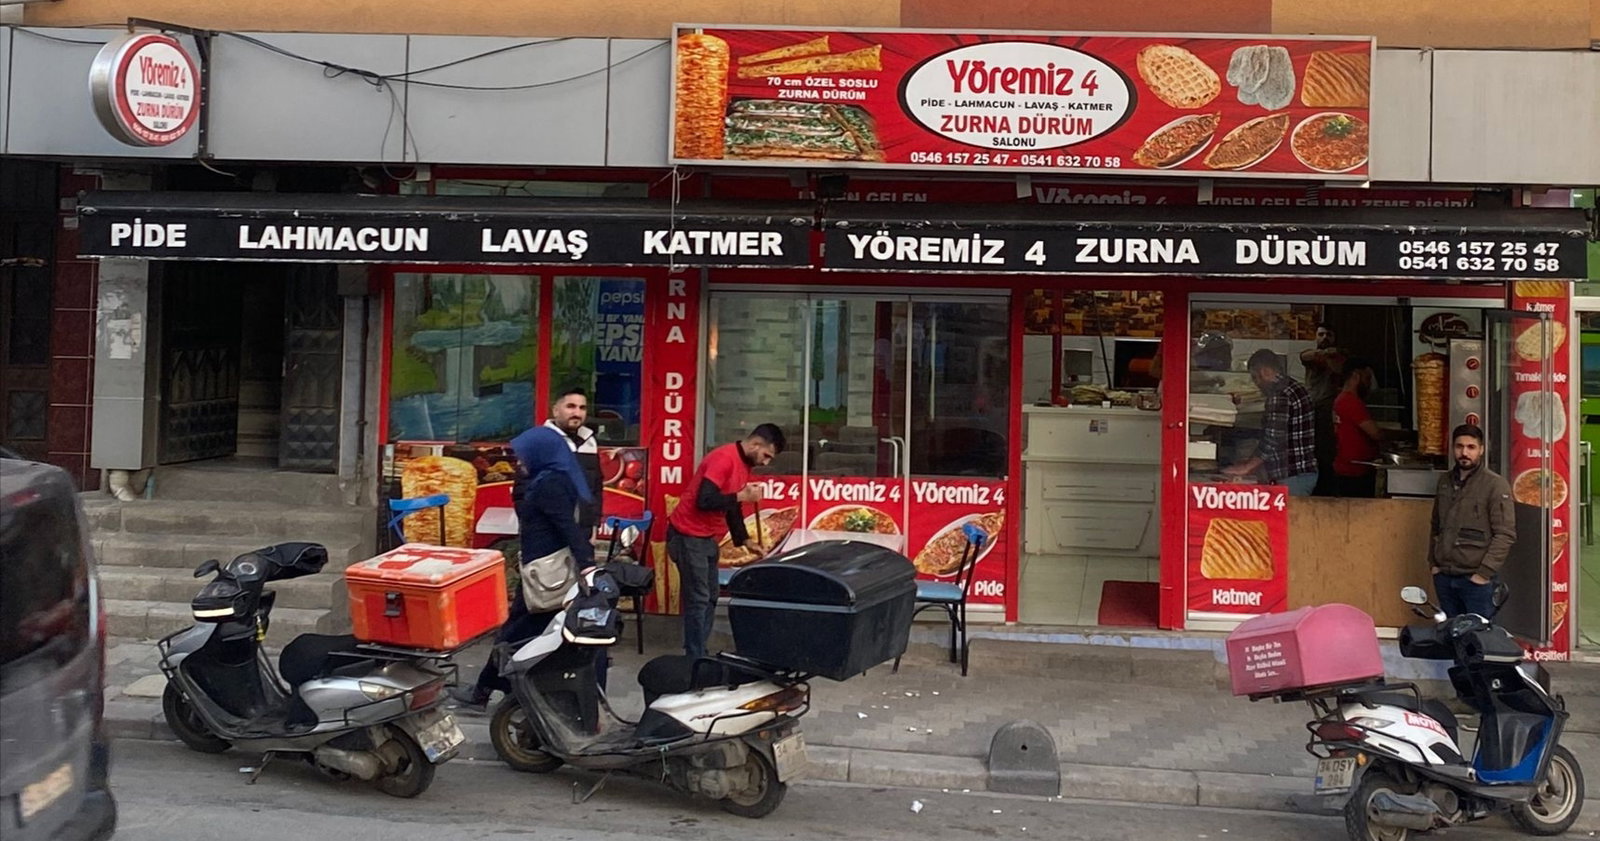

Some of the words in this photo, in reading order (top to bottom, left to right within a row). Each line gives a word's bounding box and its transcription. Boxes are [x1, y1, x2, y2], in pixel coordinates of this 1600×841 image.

[139, 55, 179, 88] Yöremiz
[181, 67, 186, 89] 4
[946, 59, 1075, 96] Yöremiz
[1080, 70, 1099, 97] 4
[767, 76, 782, 86] 70
[784, 78, 802, 87] cm
[804, 75, 836, 88] ÖZEL
[839, 78, 878, 88] SOSLU
[778, 89, 820, 100] ZURNA
[822, 88, 866, 101] DÜRÜM
[920, 98, 946, 108] PİDE
[954, 99, 1015, 110] LAHMACUN
[1024, 101, 1059, 112] LAVAŞ
[1068, 102, 1113, 112] KATMER
[940, 115, 1012, 134] ZURNA
[1018, 114, 1093, 136] DÜRÜM
[992, 136, 1036, 147] SALONU
[910, 152, 942, 164] 0546
[946, 152, 970, 164] 157
[973, 152, 990, 164] 25
[992, 153, 1009, 165] 47
[1020, 154, 1052, 166] 0541
[1056, 154, 1081, 166] 632
[1084, 155, 1100, 167] 70
[1104, 156, 1121, 168] 58
[110, 218, 187, 247] PİDE
[239, 225, 429, 252] LAHMACUN
[481, 228, 588, 260] LAVAŞ
[643, 230, 783, 256] KATMER
[847, 230, 1006, 265] YÖREMİZ
[1025, 240, 1046, 266] 4
[1075, 238, 1200, 264] ZURNA
[1236, 234, 1366, 266] DÜRÜM
[1399, 241, 1450, 256] 0546
[1456, 242, 1495, 256] 157
[1501, 242, 1527, 256] 25
[1533, 242, 1560, 257] 47
[1399, 256, 1449, 270] 0541
[1456, 257, 1496, 271] 632
[1502, 258, 1528, 272] 70
[1533, 258, 1560, 272] 58
[600, 290, 645, 306] pepsi
[593, 324, 645, 347] EPSI
[660, 372, 684, 484] DÜRÜM
[788, 482, 800, 500] 4
[809, 478, 886, 502] Yöremiz
[890, 484, 901, 502] 4
[912, 481, 990, 505] Yöremiz
[993, 487, 1005, 505] 4
[1192, 485, 1270, 512] Yöremiz
[1273, 493, 1286, 512] 4
[974, 580, 1005, 596] Pide
[1212, 588, 1263, 606] Katmer
